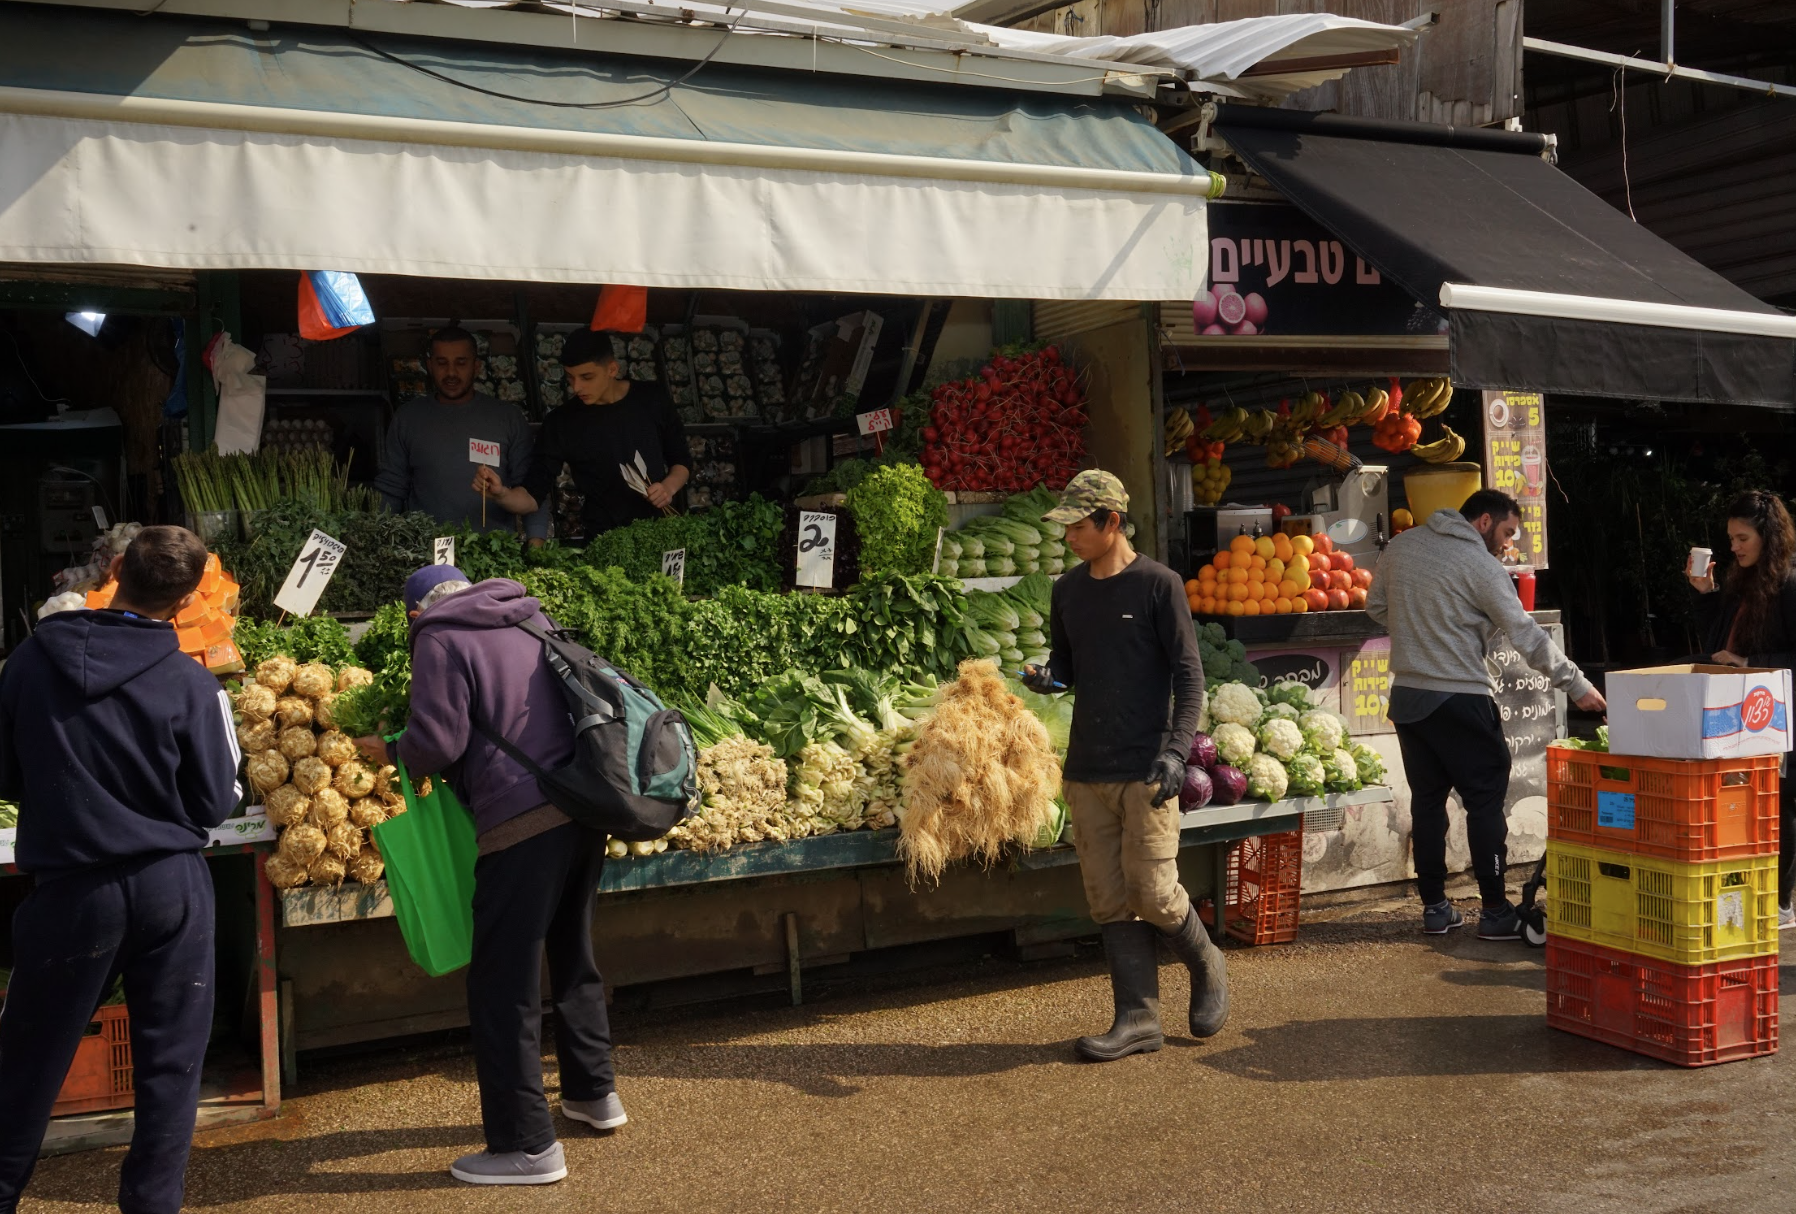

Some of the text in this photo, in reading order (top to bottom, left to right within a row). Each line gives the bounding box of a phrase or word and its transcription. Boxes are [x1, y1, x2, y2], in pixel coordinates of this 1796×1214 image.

[1211, 237, 1344, 288] טבעיים
[1506, 396, 1540, 406] אספרסו
[1528, 407, 1540, 426] 5
[1491, 440, 1521, 455] שייק
[1493, 455, 1521, 467] פירות
[1495, 469, 1515, 487] 10
[1523, 521, 1542, 533] גזר
[799, 523, 830, 553] 2
[1532, 534, 1543, 554] 5
[436, 547, 449, 565] 3
[1351, 659, 1389, 677] שייק
[1353, 677, 1389, 692] פירות
[1354, 694, 1380, 716] 10
[235, 820, 266, 833] מרינה
